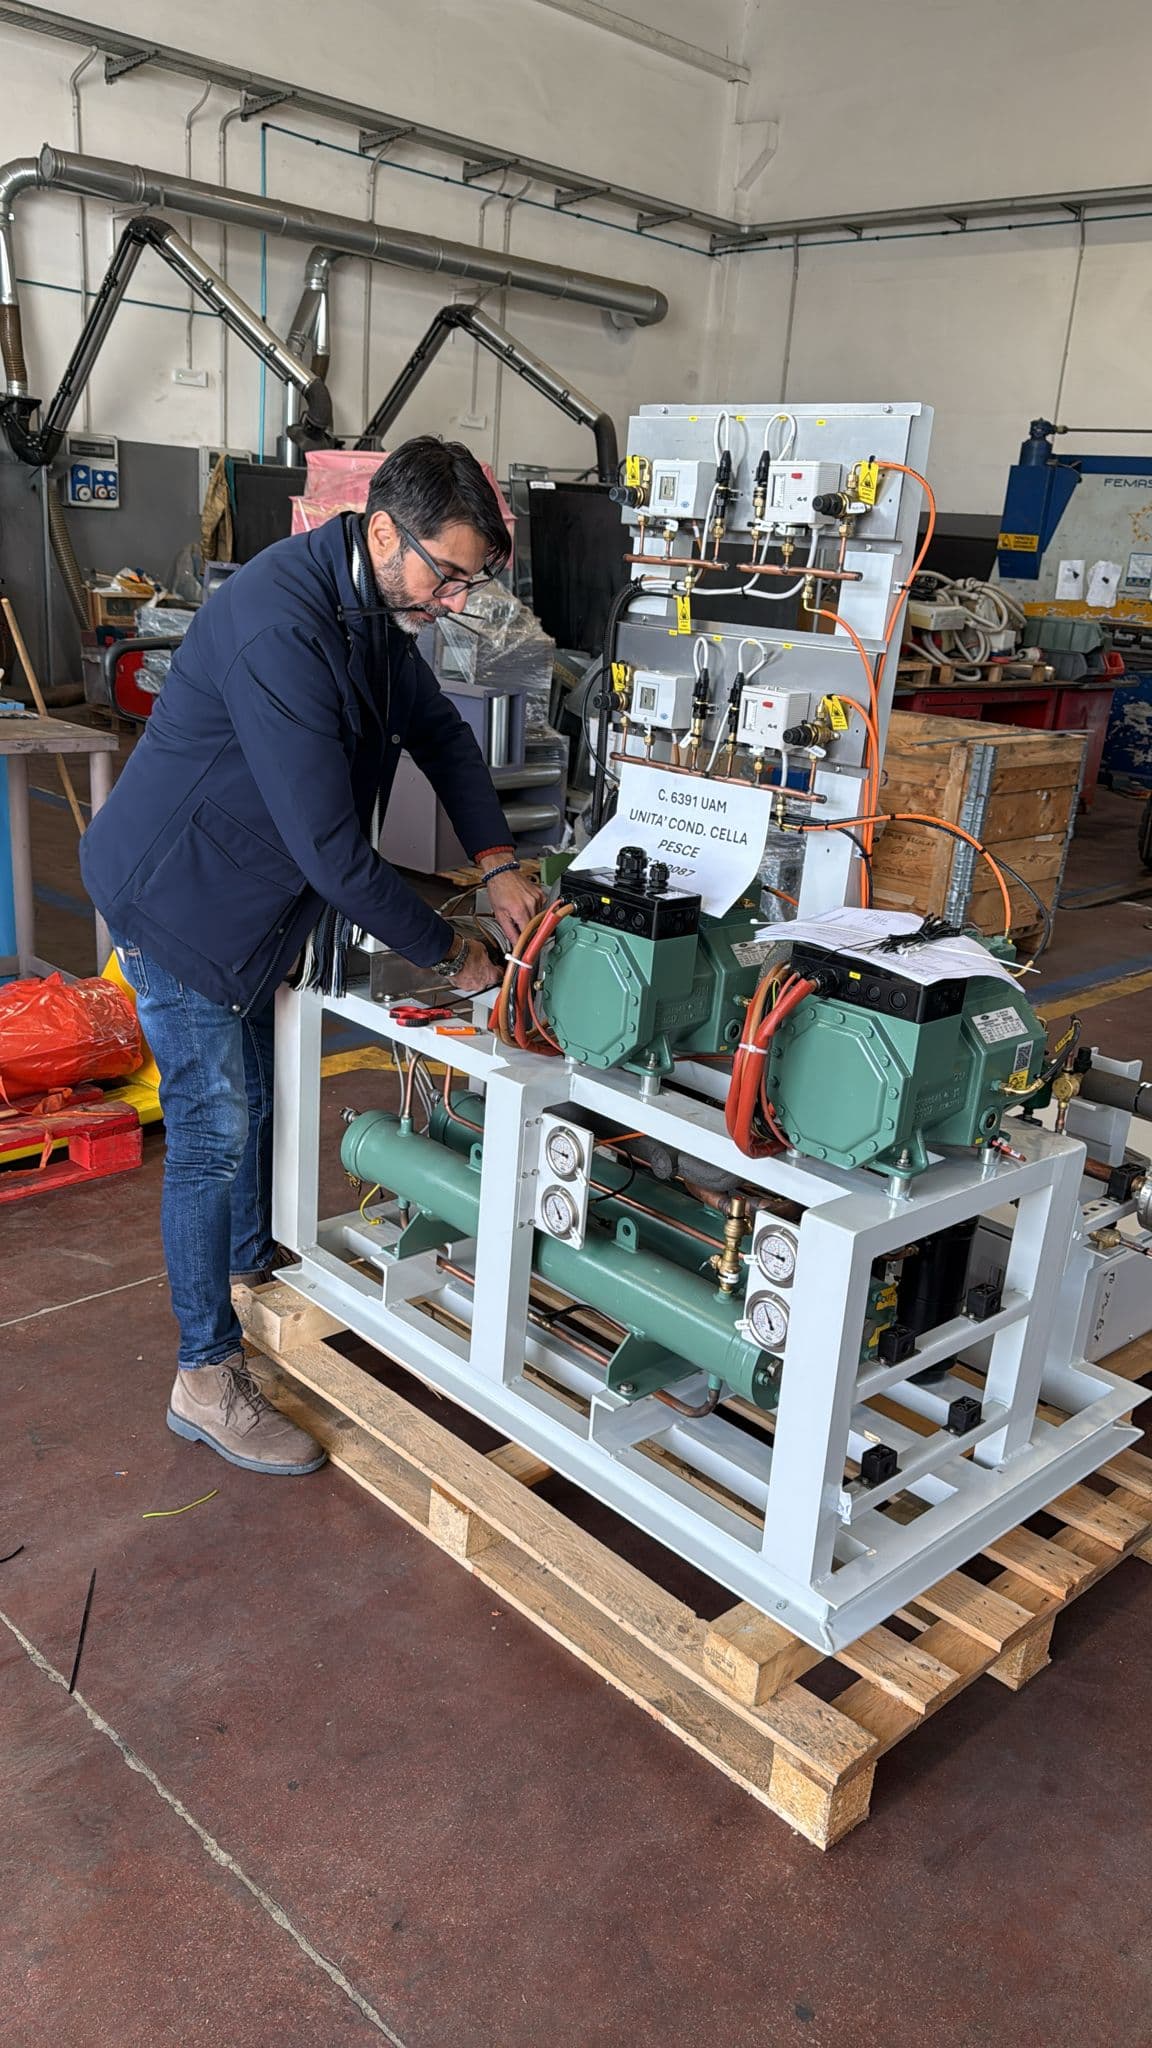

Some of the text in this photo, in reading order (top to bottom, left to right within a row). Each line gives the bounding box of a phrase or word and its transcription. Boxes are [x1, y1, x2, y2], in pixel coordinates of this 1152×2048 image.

[658, 788, 727, 813] C. 6391 UAM
[629, 808, 748, 846] UNITA' COND. CELLA
[657, 839, 700, 858] PESCE
